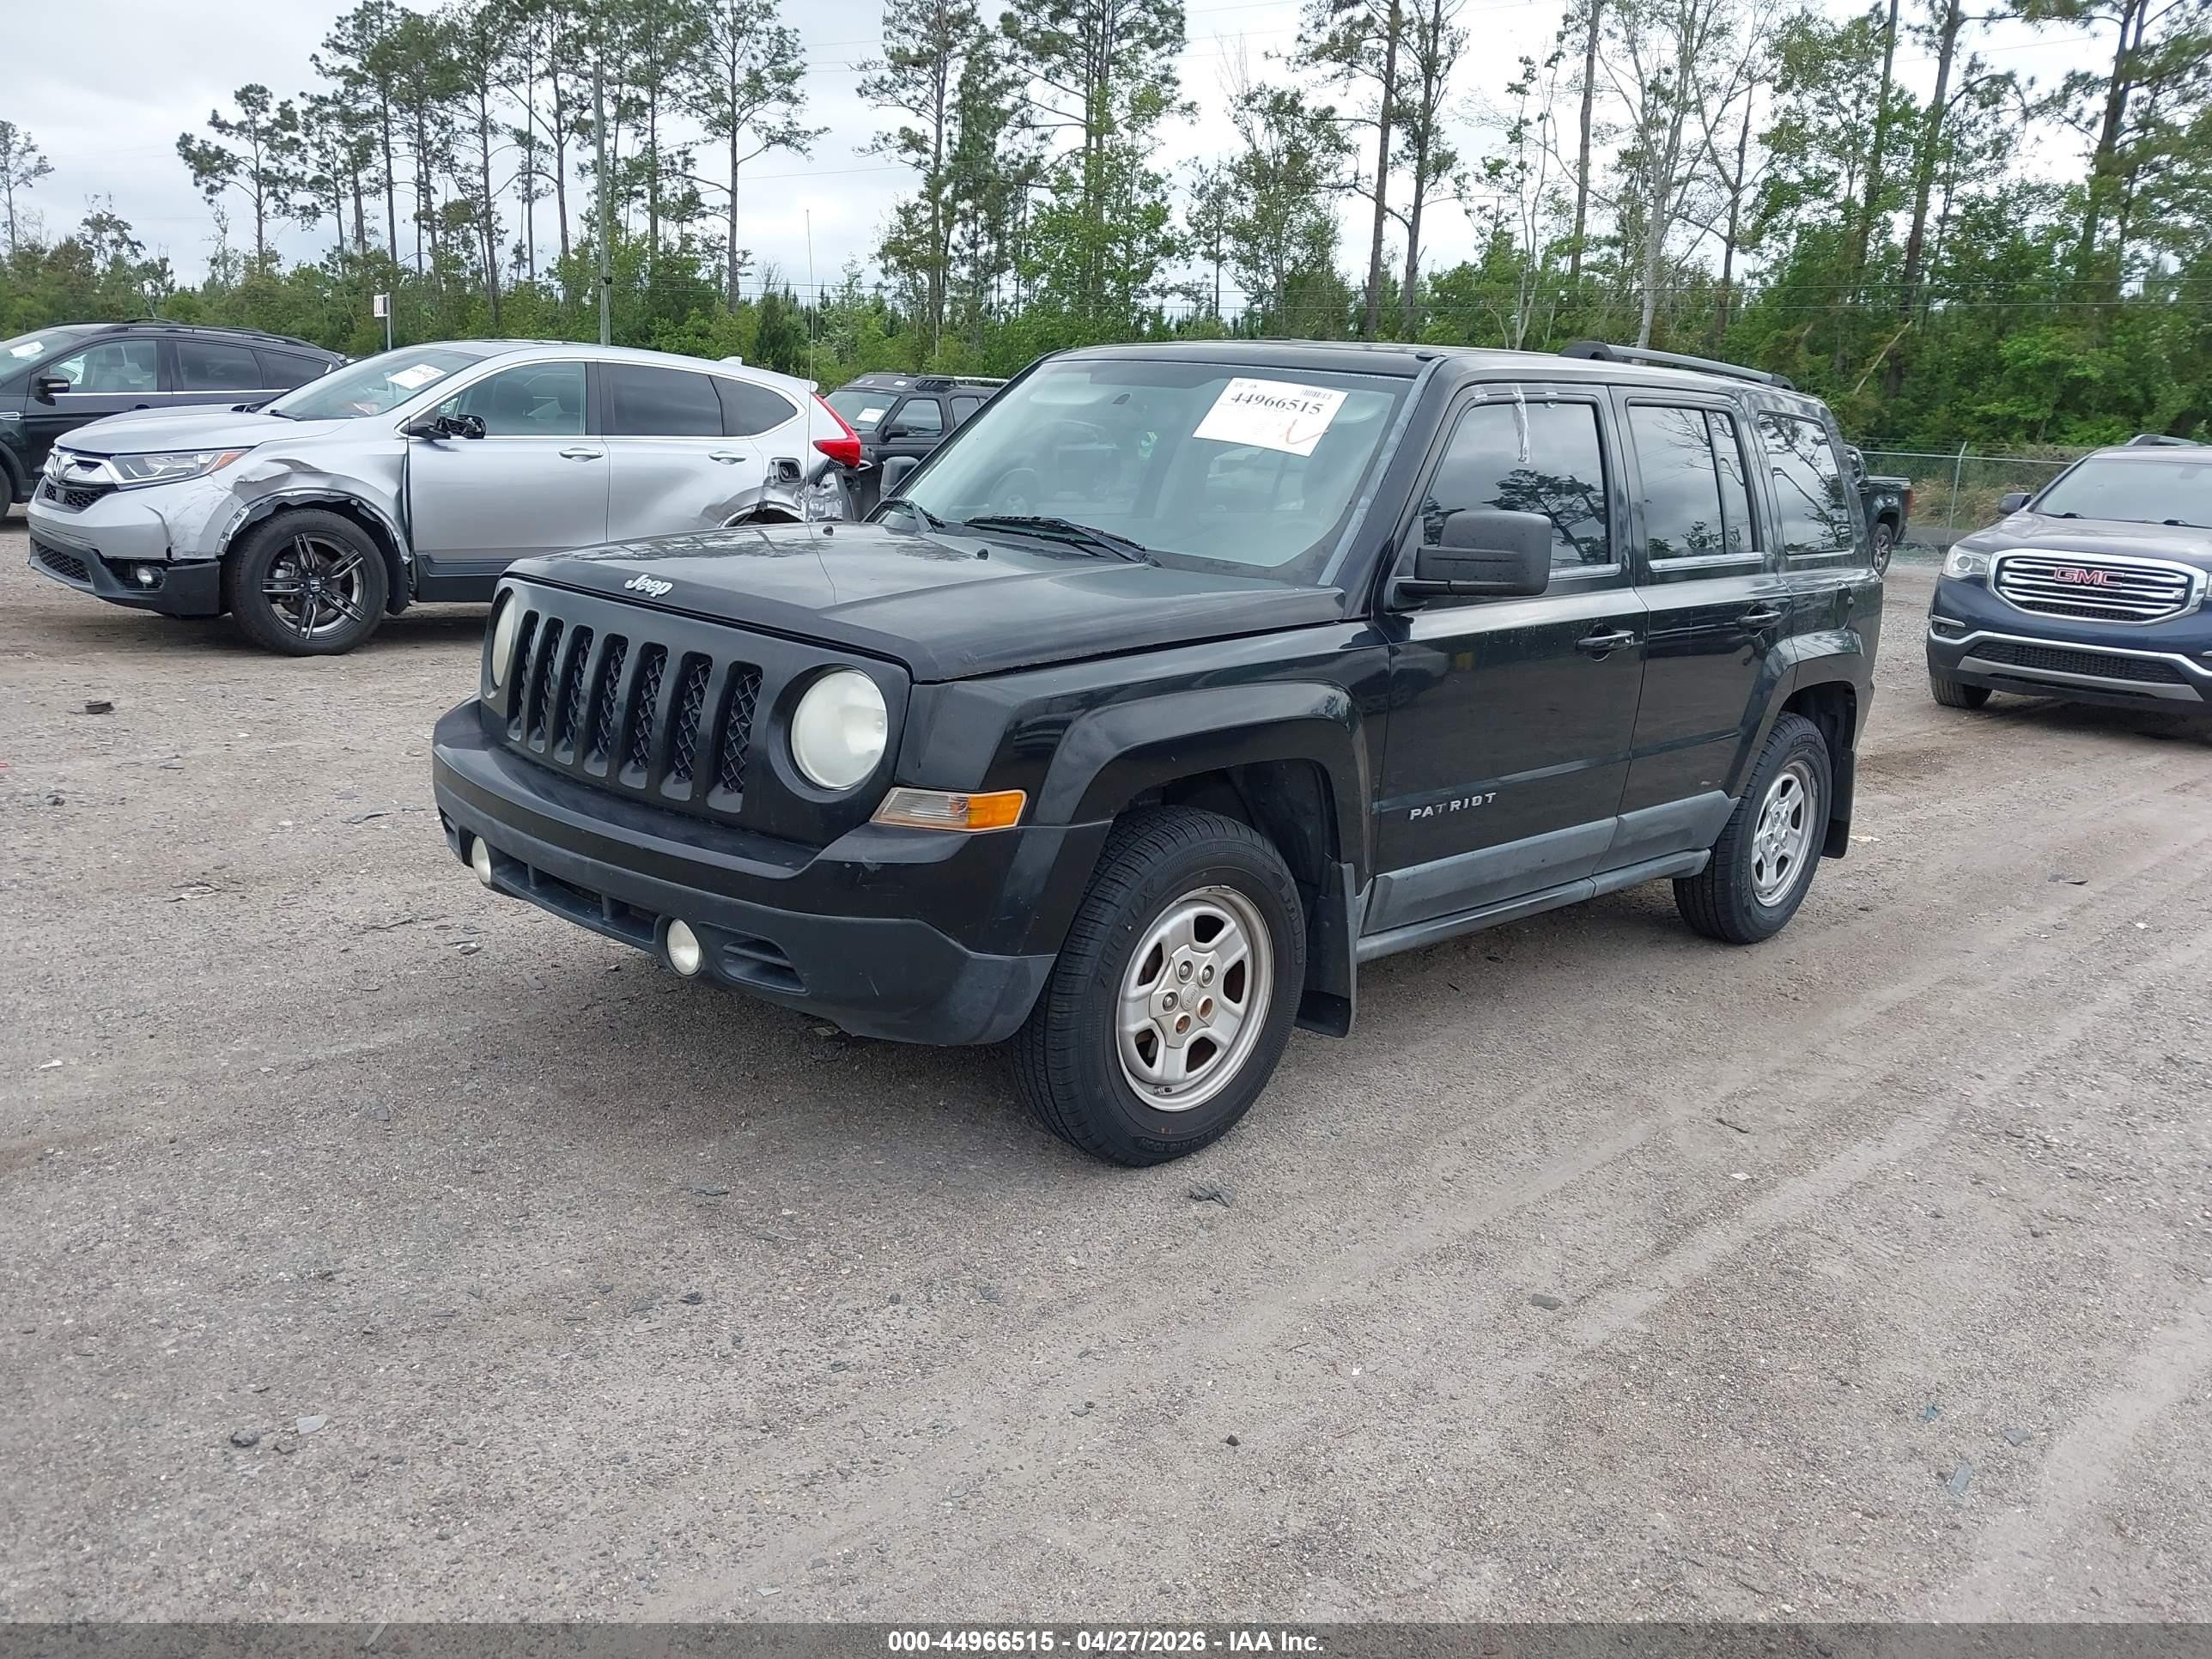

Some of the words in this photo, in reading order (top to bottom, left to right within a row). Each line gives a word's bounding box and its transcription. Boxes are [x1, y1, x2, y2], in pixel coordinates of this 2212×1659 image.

[1231, 392, 1323, 415] 44966515
[624, 574, 673, 598] Jeep
[2053, 567, 2125, 587] GMC
[1408, 792, 1497, 821] PATRIOT
